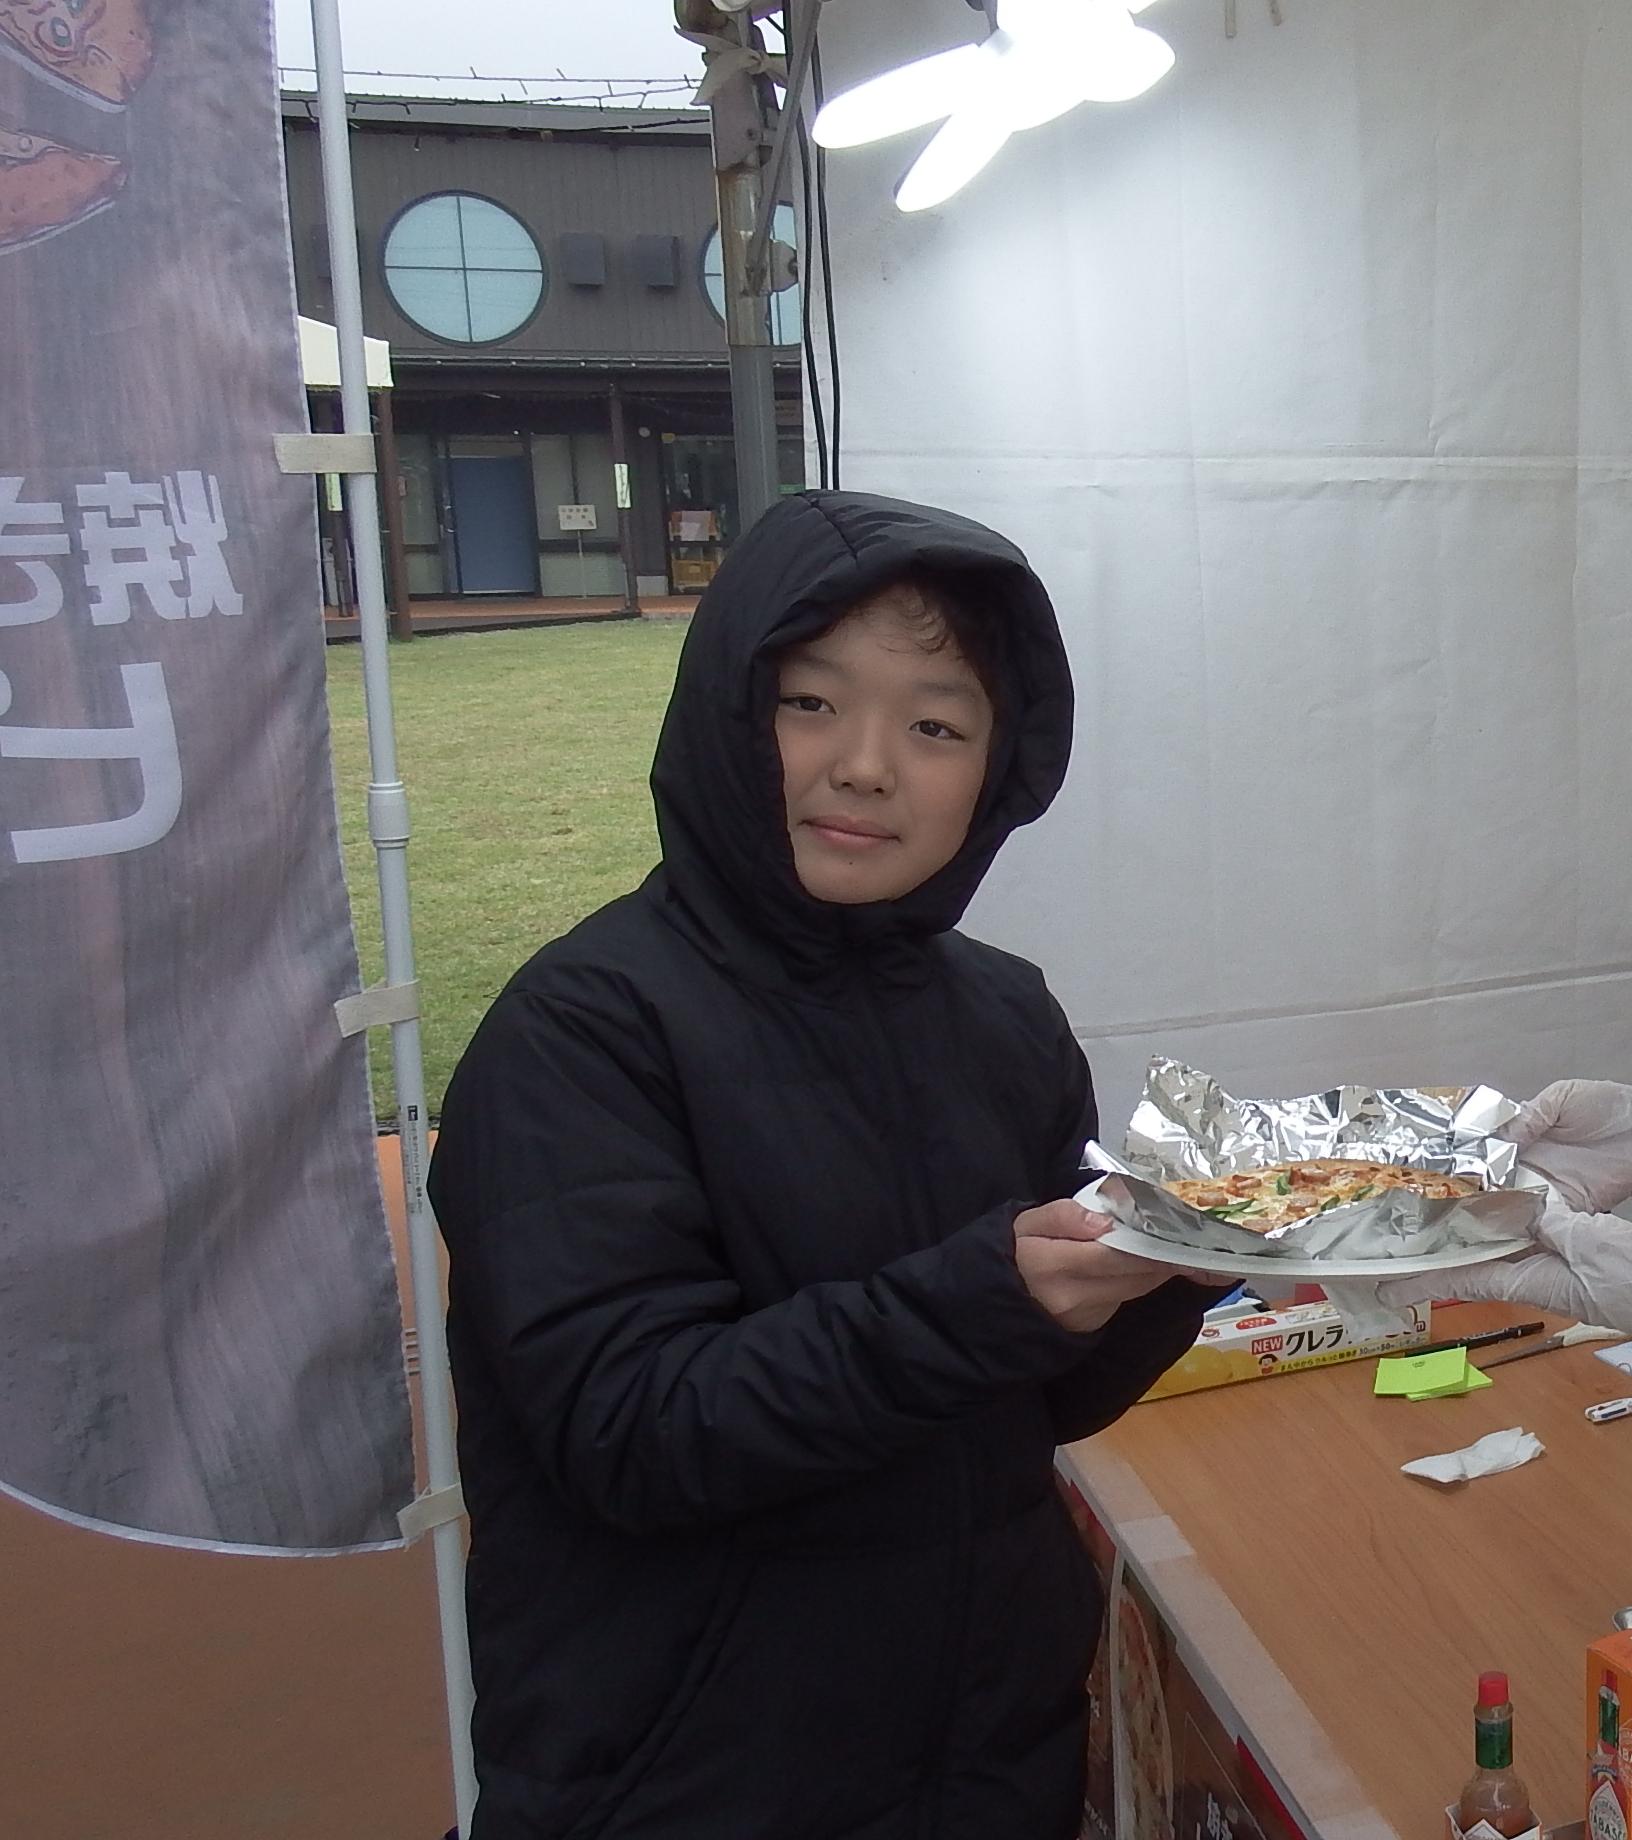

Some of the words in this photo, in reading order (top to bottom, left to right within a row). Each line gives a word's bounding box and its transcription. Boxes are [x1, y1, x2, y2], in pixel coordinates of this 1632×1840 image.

[1253, 1336, 1283, 1354] NEW
[1286, 1324, 1350, 1356] クレラ
